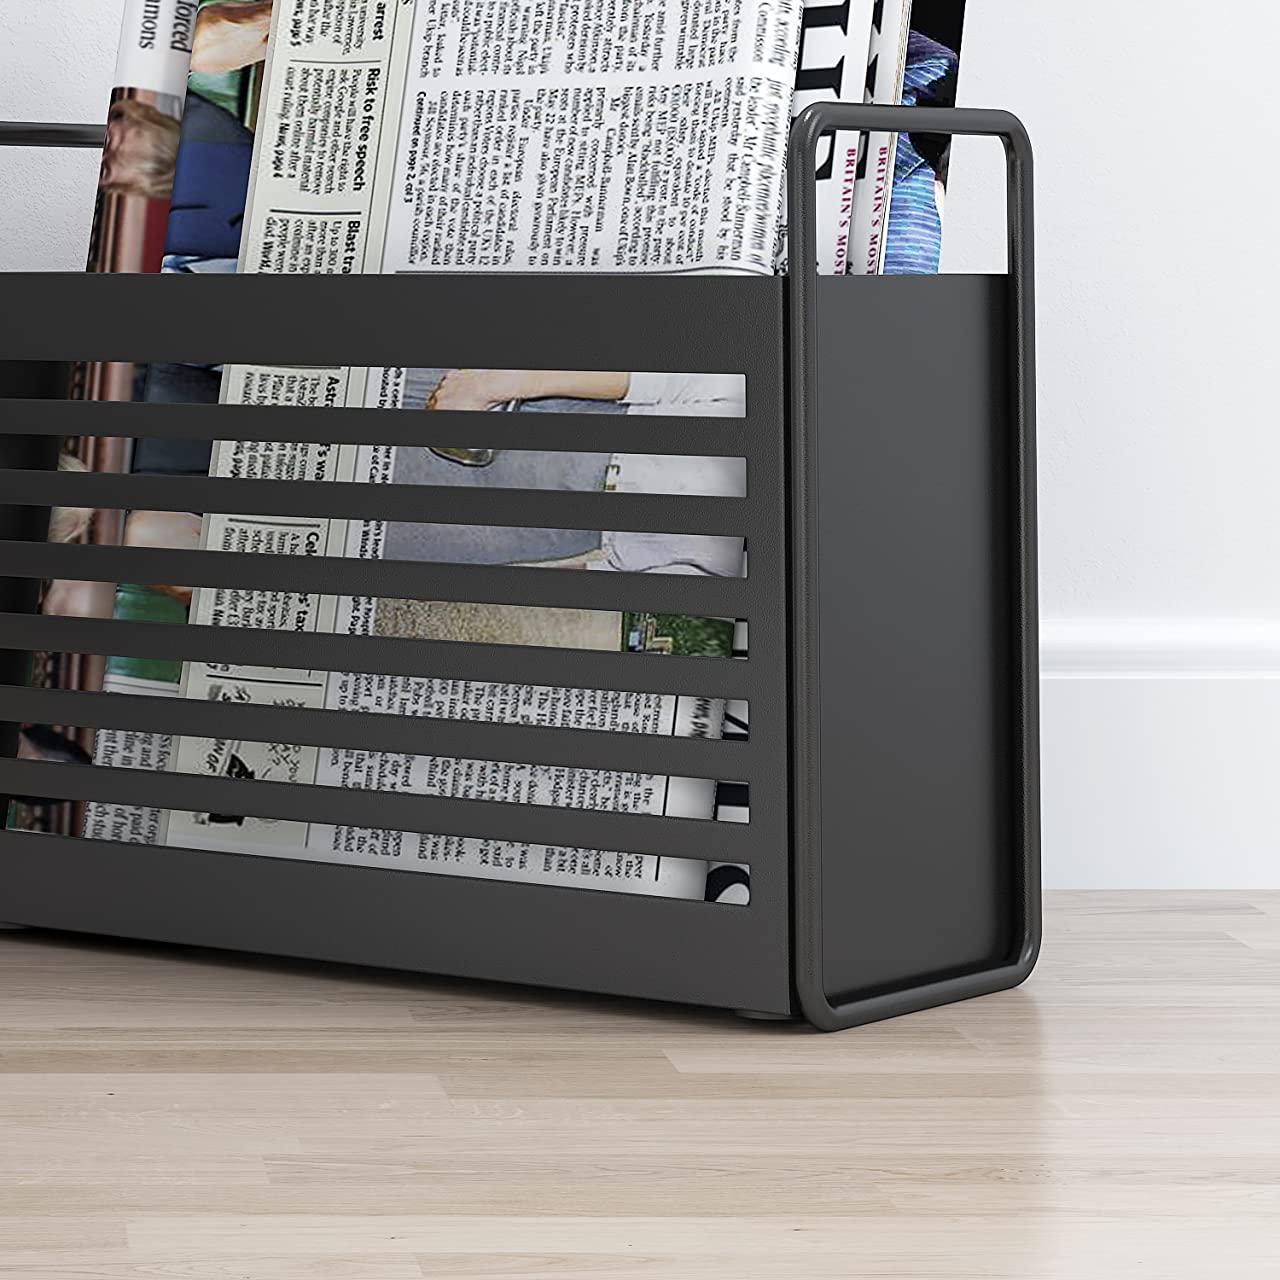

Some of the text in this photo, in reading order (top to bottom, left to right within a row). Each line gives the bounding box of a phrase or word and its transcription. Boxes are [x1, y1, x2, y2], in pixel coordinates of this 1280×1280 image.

[170, 0, 199, 53] forced
[372, 2, 386, 40] arrest
[353, 68, 381, 190] Risk to free speech
[839, 149, 856, 227] BRITAIN'S
